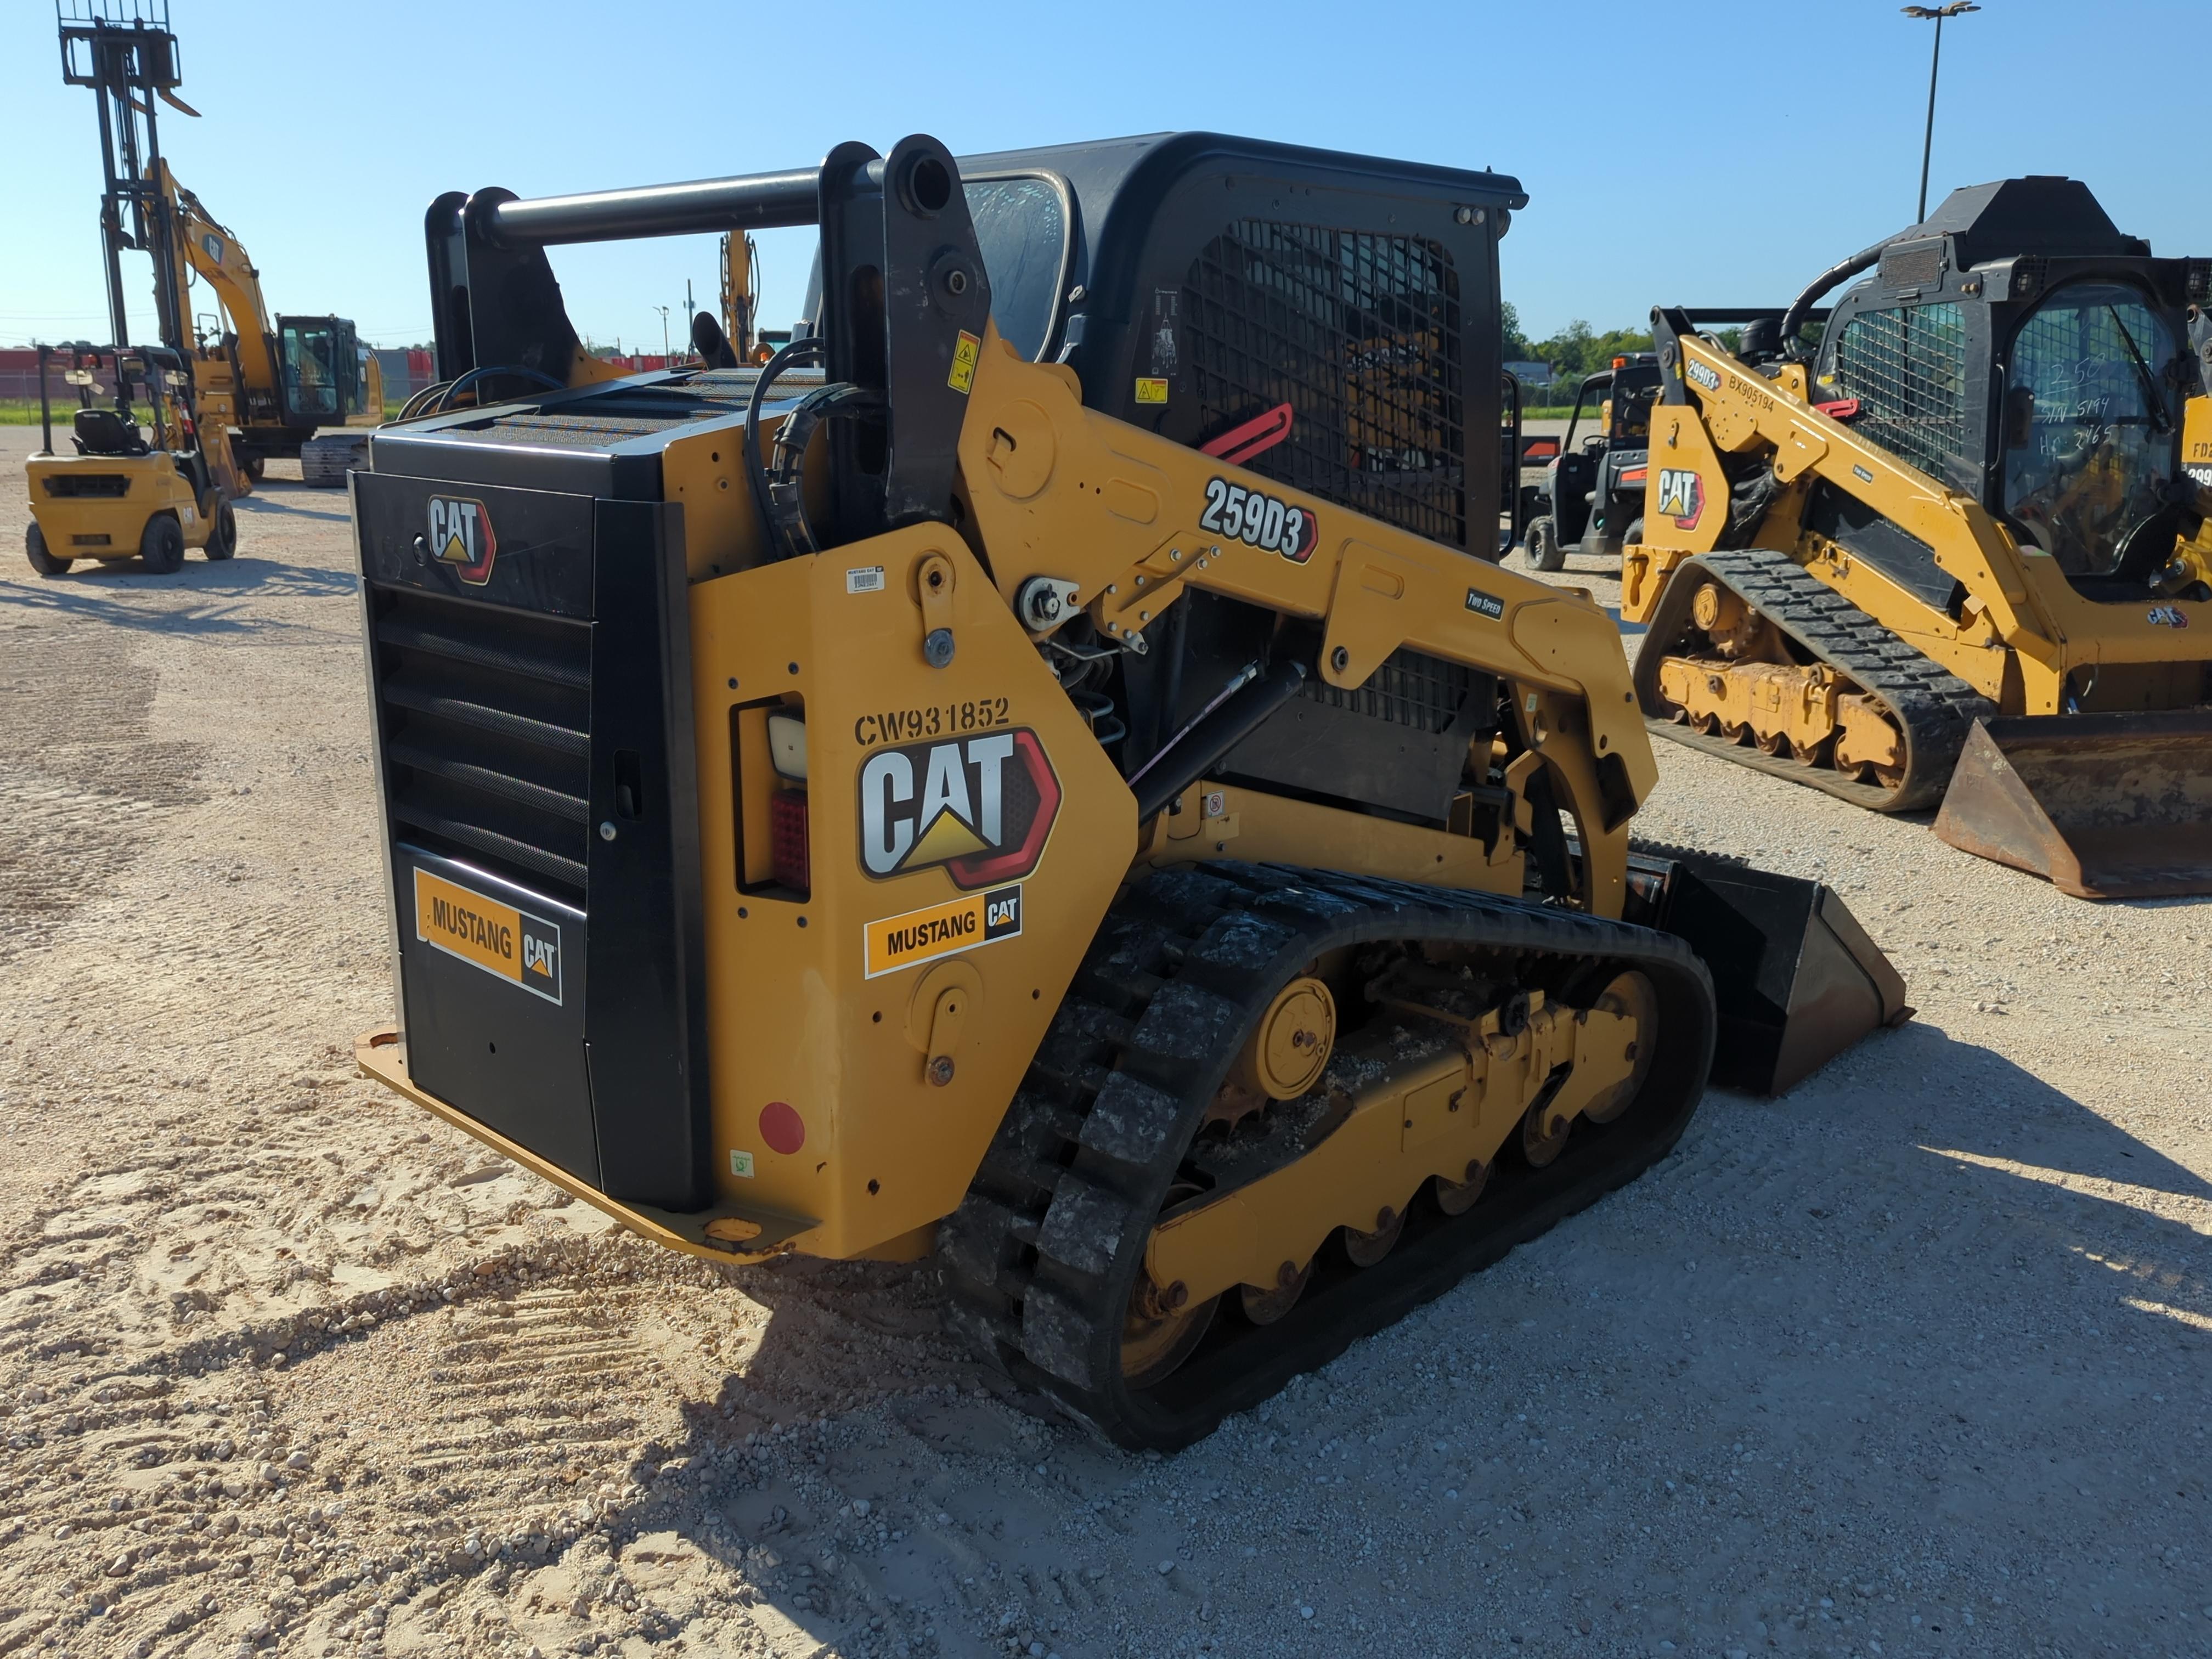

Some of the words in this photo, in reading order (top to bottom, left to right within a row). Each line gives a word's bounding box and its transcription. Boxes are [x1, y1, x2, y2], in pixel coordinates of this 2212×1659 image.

[1688, 359, 1717, 390] 299D3
[2051, 352, 2106, 384] 250
[1729, 376, 1774, 413] BX905194
[2077, 397, 2110, 418] 5194
[2074, 425, 2117, 450] 2465
[1659, 470, 1695, 516] CAT
[430, 499, 476, 562] CAT
[1201, 479, 1302, 555] 259D3
[2147, 606, 2177, 624] CAT
[855, 697, 1009, 746] CW931852
[862, 733, 1013, 873] CAT
[433, 896, 512, 960] MUSTANG
[523, 934, 555, 979] CAT
[888, 911, 975, 956] MUSTANG
[988, 898, 1017, 927] CAT
